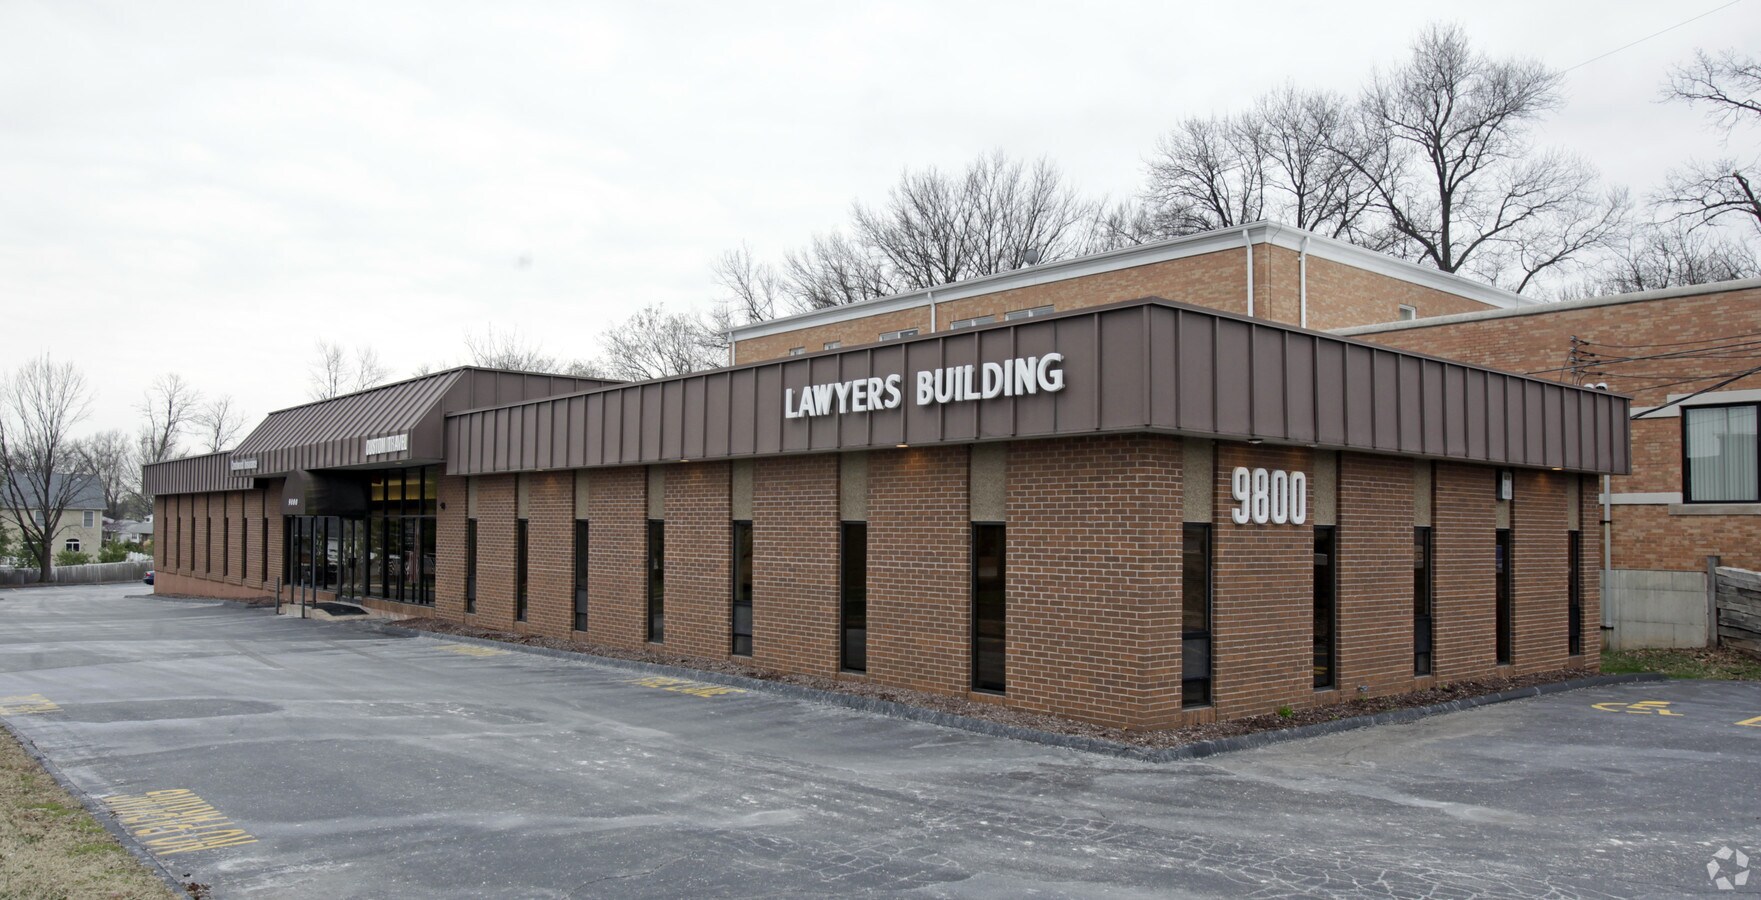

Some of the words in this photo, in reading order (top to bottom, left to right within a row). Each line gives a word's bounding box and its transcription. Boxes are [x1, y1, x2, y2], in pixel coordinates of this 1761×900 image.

[785, 374, 902, 419] LAWYERS
[917, 352, 1065, 406] BUILDING
[1231, 466, 1307, 525] 9800
[102, 788, 236, 837] PARKING
[144, 828, 259, 856] NO
